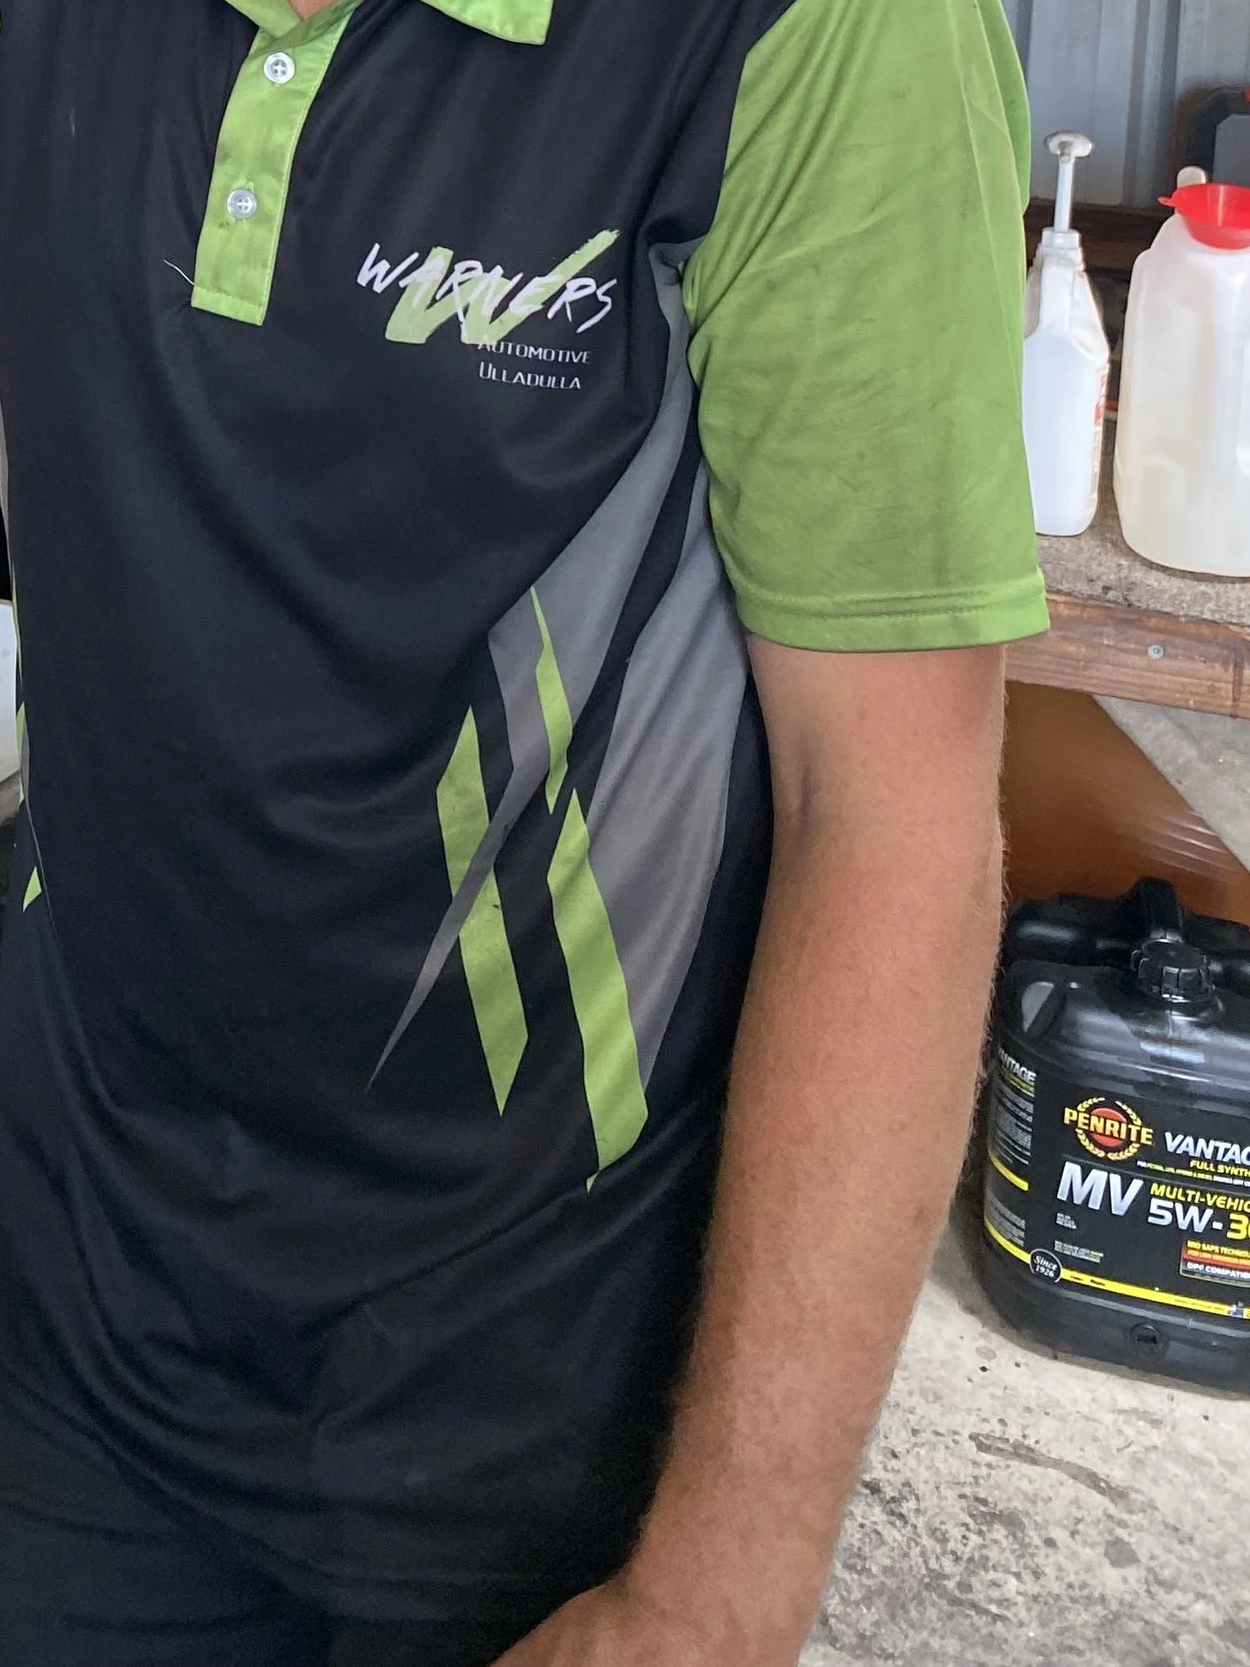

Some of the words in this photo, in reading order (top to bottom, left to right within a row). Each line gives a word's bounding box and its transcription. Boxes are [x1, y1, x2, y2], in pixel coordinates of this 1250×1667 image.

[356, 242, 617, 334] WARNERS
[477, 335, 592, 365] AUTOMOTIVE
[479, 361, 582, 390] ULLADULLA
[1062, 1107, 1154, 1146] PENRITE
[1190, 1159, 1216, 1172] FULL
[1056, 1161, 1144, 1217] MV
[1147, 1197, 1250, 1240] 5W-3
[1034, 1255, 1057, 1271] Since
[1035, 1265, 1055, 1278] 1926
